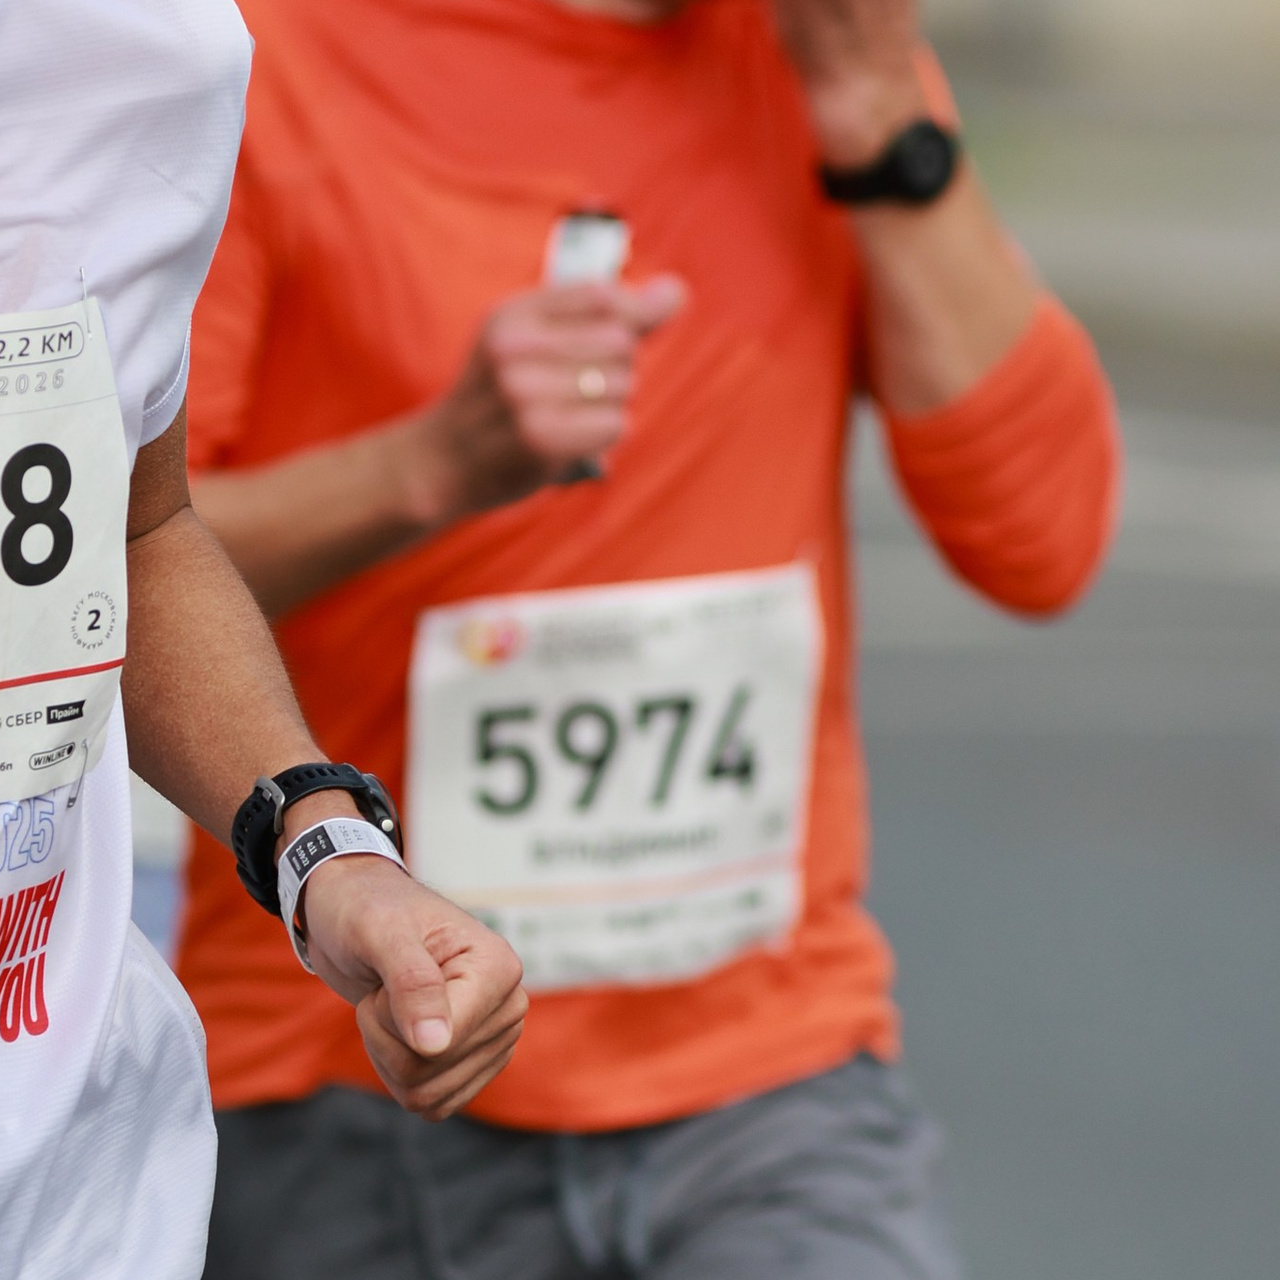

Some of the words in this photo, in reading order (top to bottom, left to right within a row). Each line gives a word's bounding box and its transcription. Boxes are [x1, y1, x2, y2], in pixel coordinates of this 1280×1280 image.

[87, 608, 101, 632] 2
[5, 710, 43, 727] СБЕР
[50, 706, 80, 720] Прайм
[33, 748, 67, 766] WINLINE
[474, 684, 756, 816] 5974
